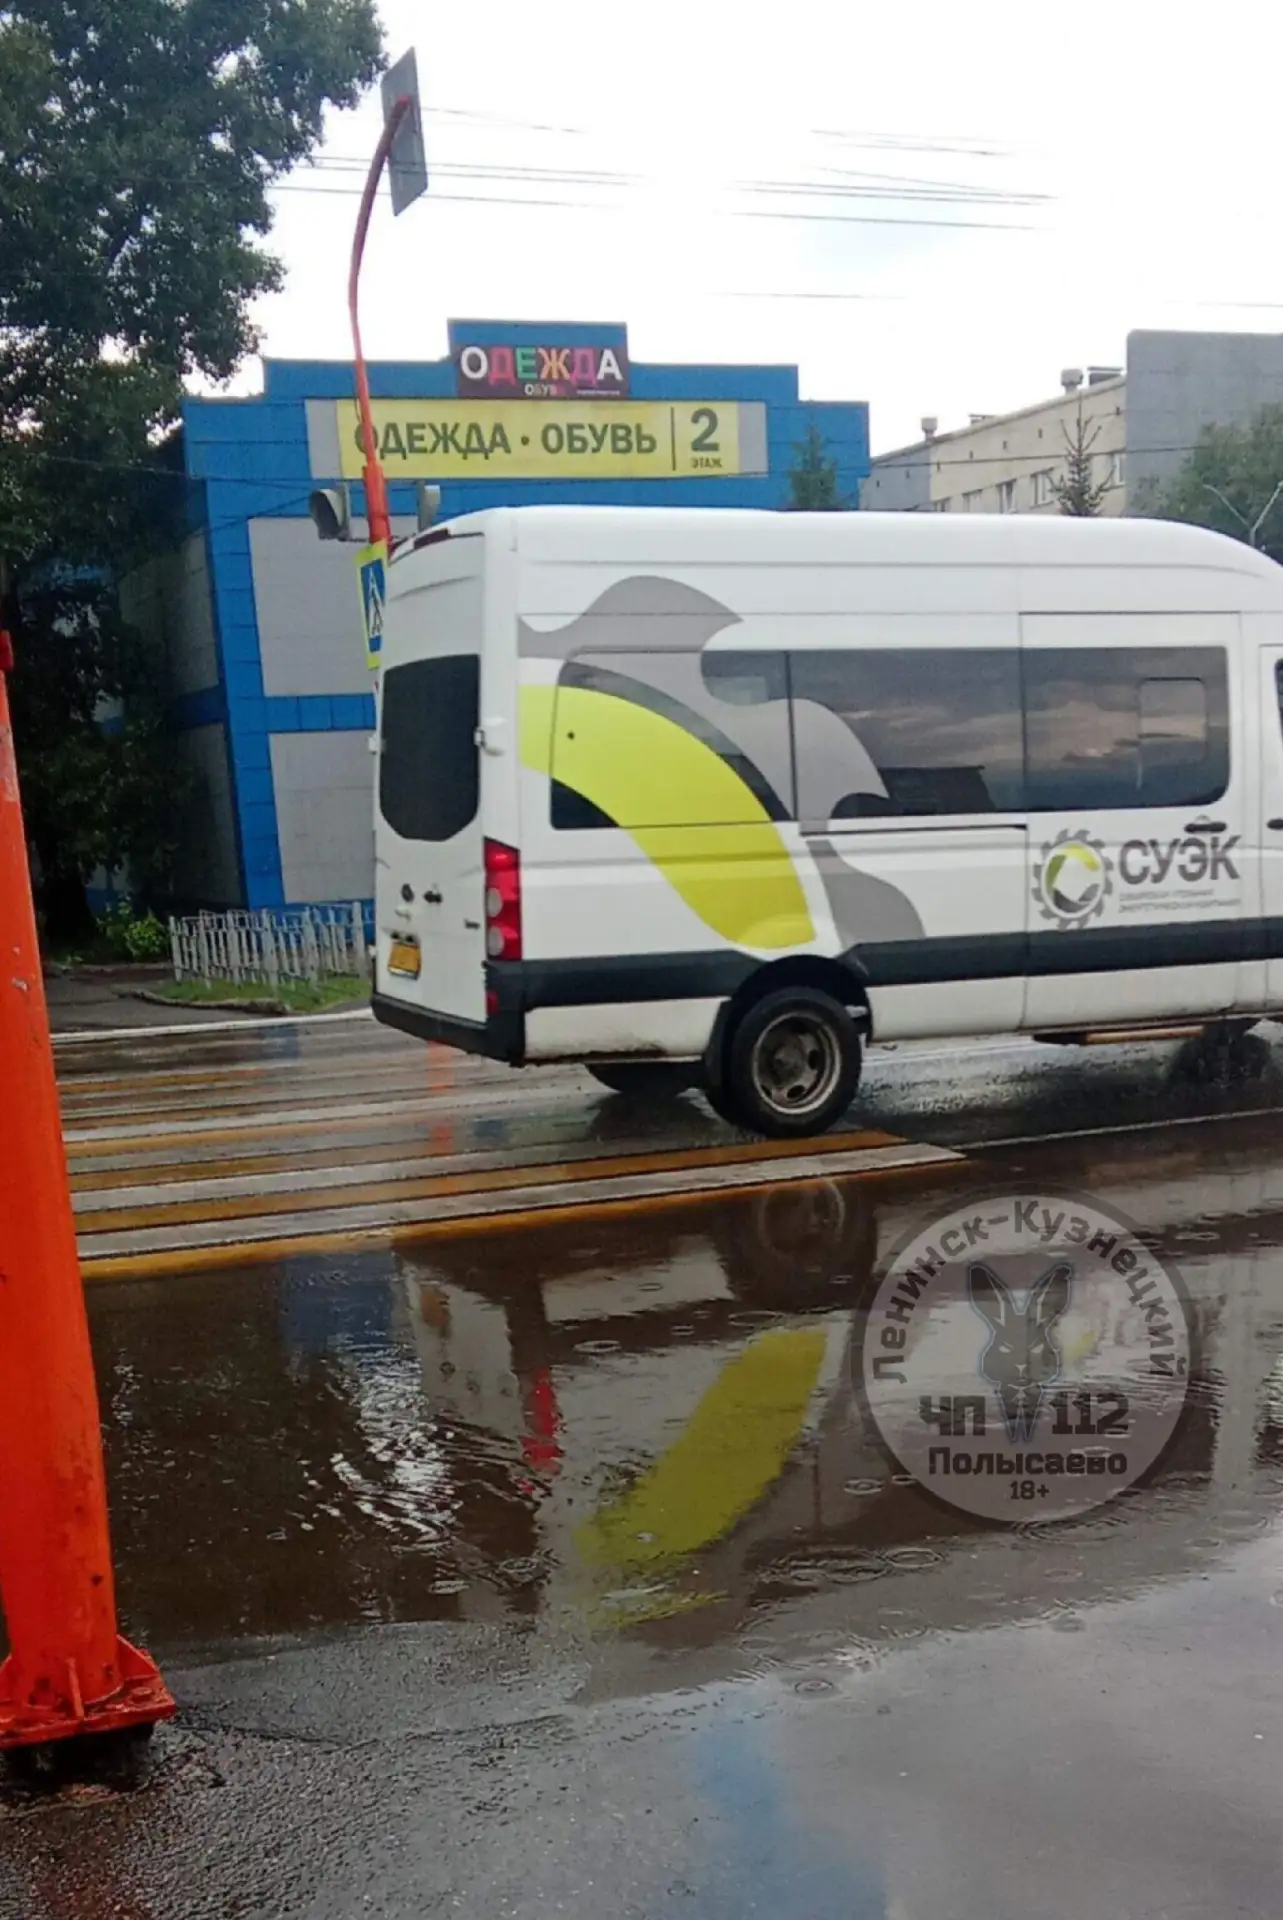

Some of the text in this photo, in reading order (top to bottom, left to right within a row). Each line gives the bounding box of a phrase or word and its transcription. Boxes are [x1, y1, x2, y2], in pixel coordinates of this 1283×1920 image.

[460, 346, 624, 386] ОДЕЖДА
[541, 422, 658, 454] ОБУВЬ
[691, 407, 720, 452] 2
[691, 457, 722, 469] ЭТАЖ
[1119, 835, 1241, 885] СУЭК
